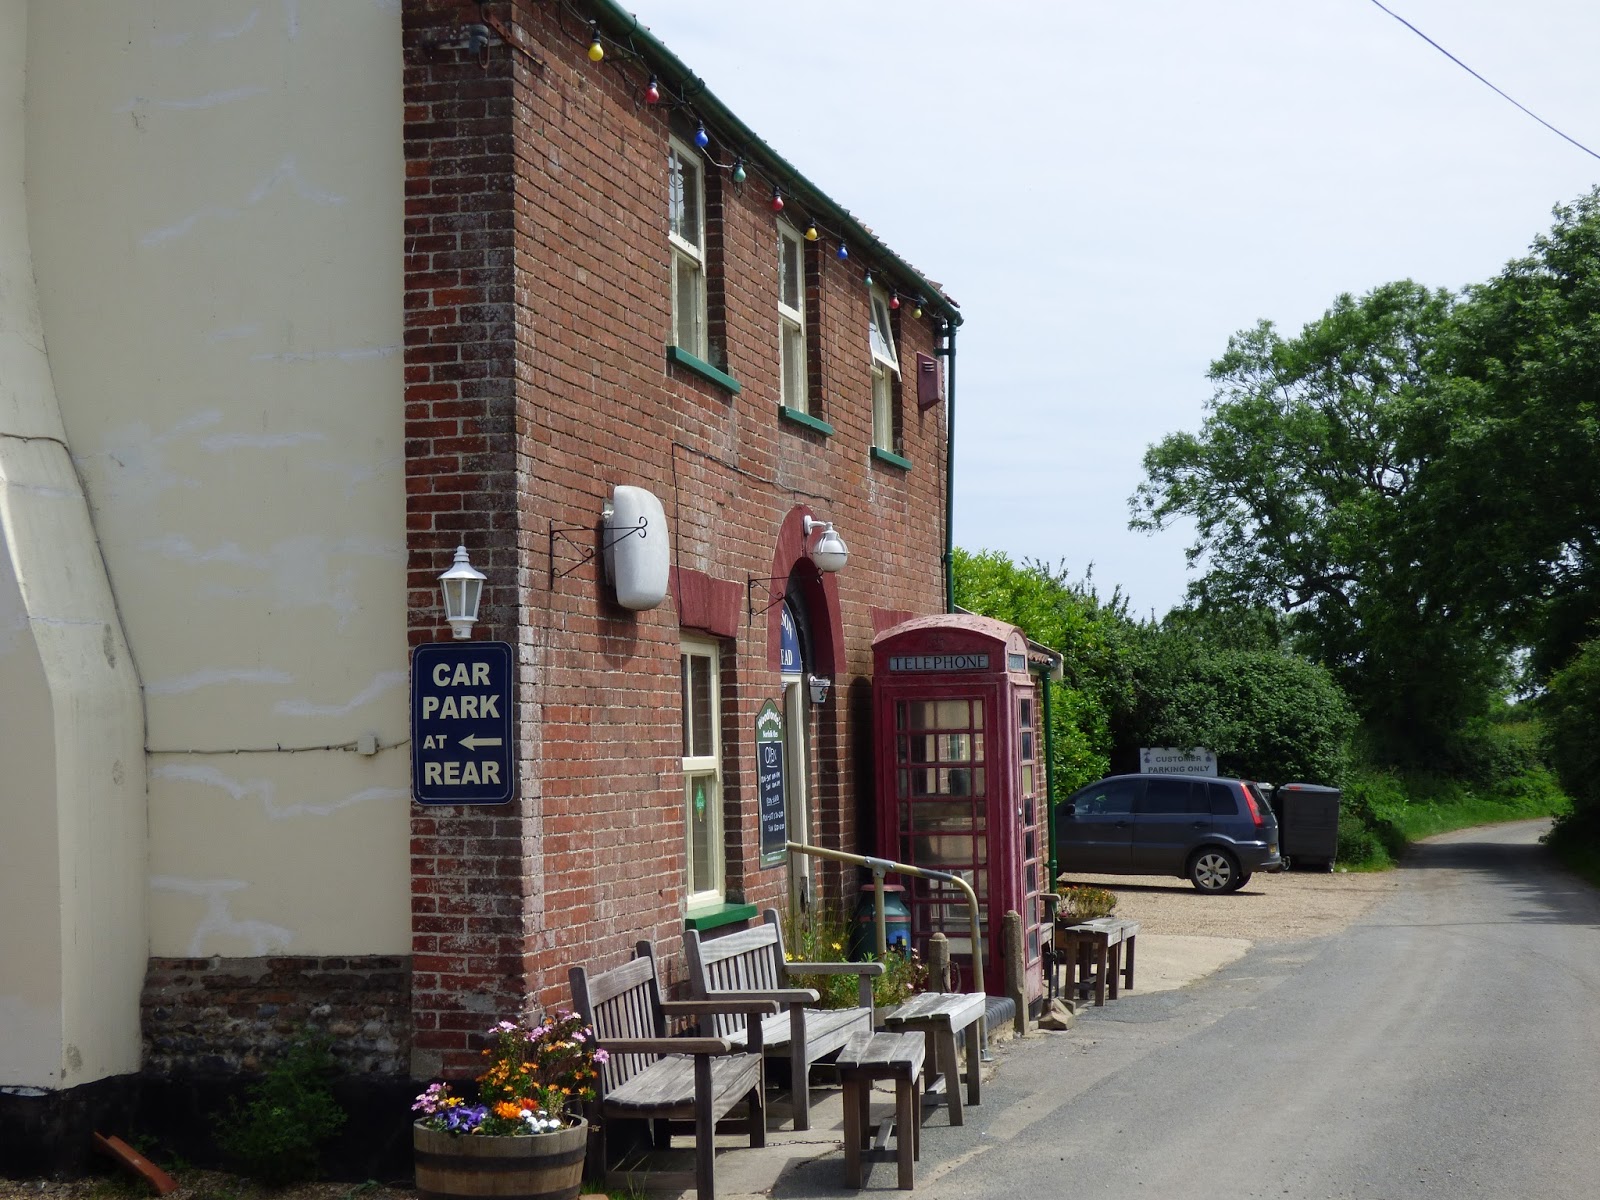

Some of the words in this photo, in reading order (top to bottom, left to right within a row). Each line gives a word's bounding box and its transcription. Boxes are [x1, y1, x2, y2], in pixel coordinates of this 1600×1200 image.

[892, 655, 986, 670] TELEPHONE
[432, 662, 491, 687] CAR
[422, 694, 501, 720] PARK
[422, 734, 448, 750] AT
[1155, 755, 1202, 763] CUSTOMER
[424, 761, 501, 785] REAR
[1148, 766, 1185, 774] PARKING
